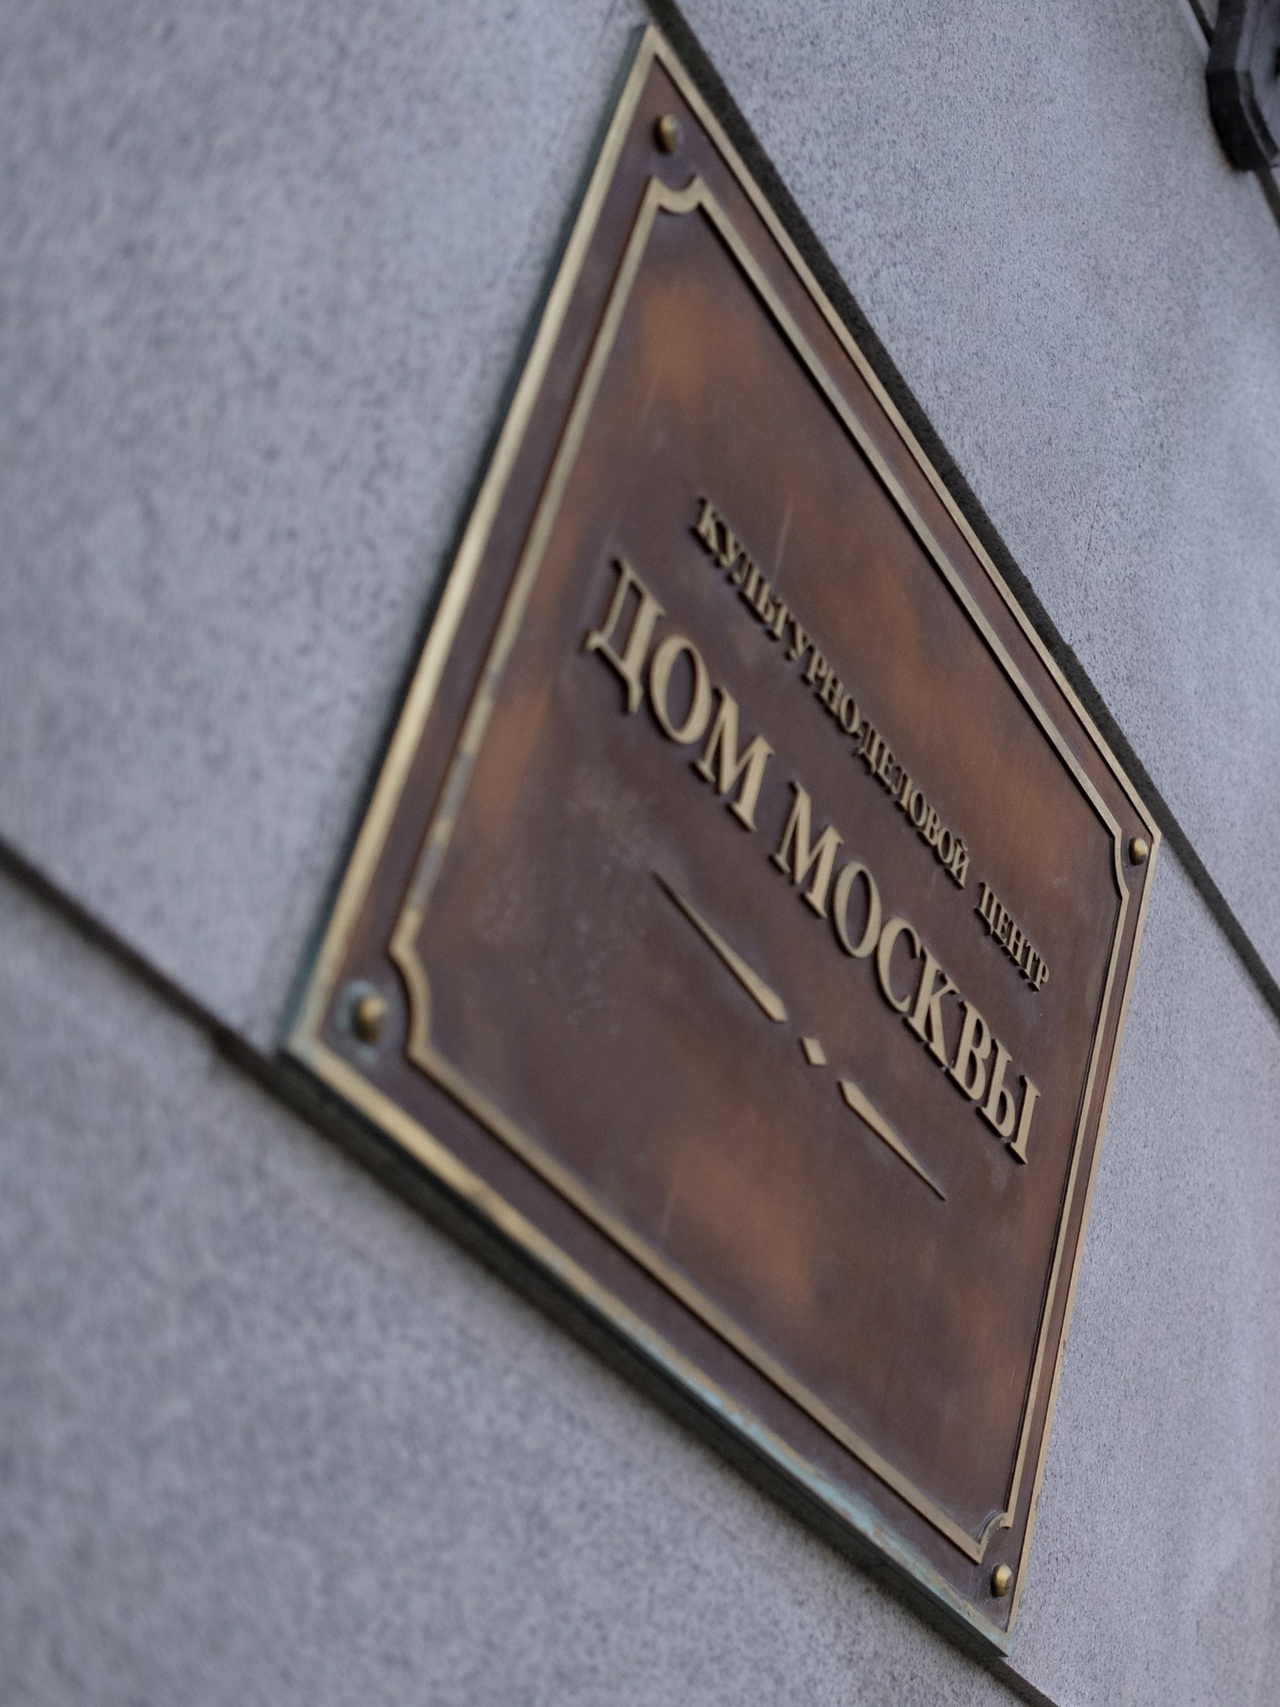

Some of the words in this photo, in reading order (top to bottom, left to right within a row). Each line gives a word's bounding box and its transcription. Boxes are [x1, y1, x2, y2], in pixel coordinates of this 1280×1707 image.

[586, 556, 775, 831] ДОМ
[770, 779, 1041, 1164] МОСКВЫ
[691, 498, 970, 889] КУЛЬТУРНО-ДЕЛОВОЙ
[975, 882, 1050, 991] ЦЕНТР
